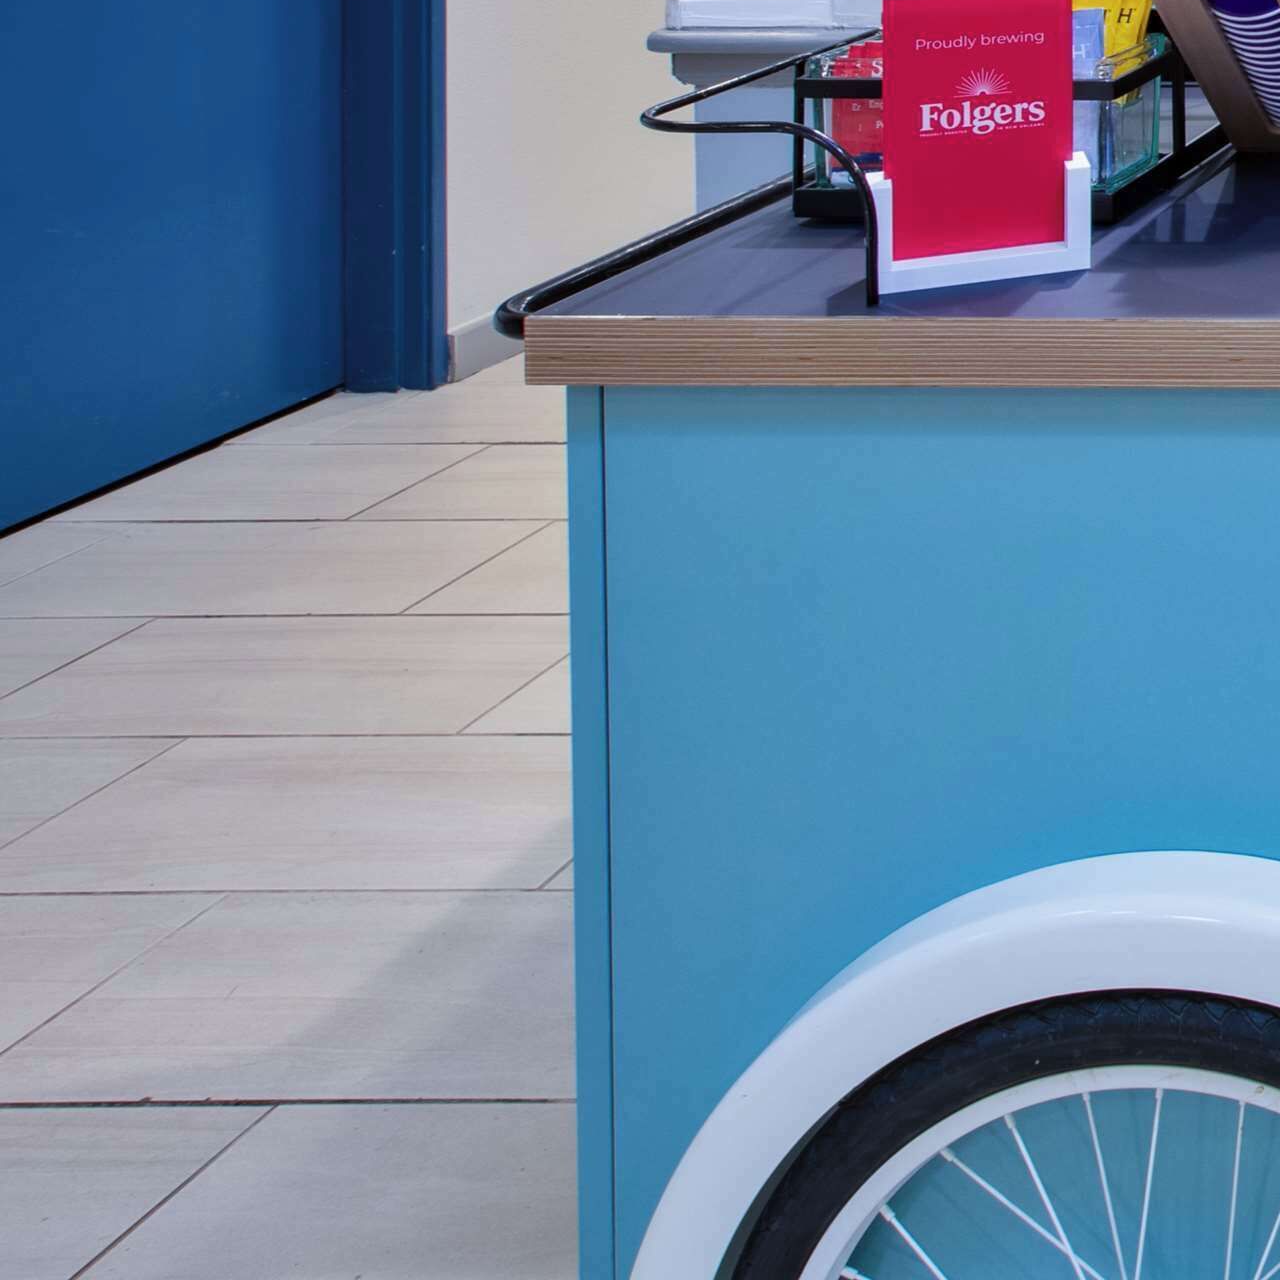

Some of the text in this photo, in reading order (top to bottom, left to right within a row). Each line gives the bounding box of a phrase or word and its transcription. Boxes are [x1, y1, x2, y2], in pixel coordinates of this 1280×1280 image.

[915, 31, 1045, 51] Proudly brewing
[919, 100, 1046, 135] Folgers
